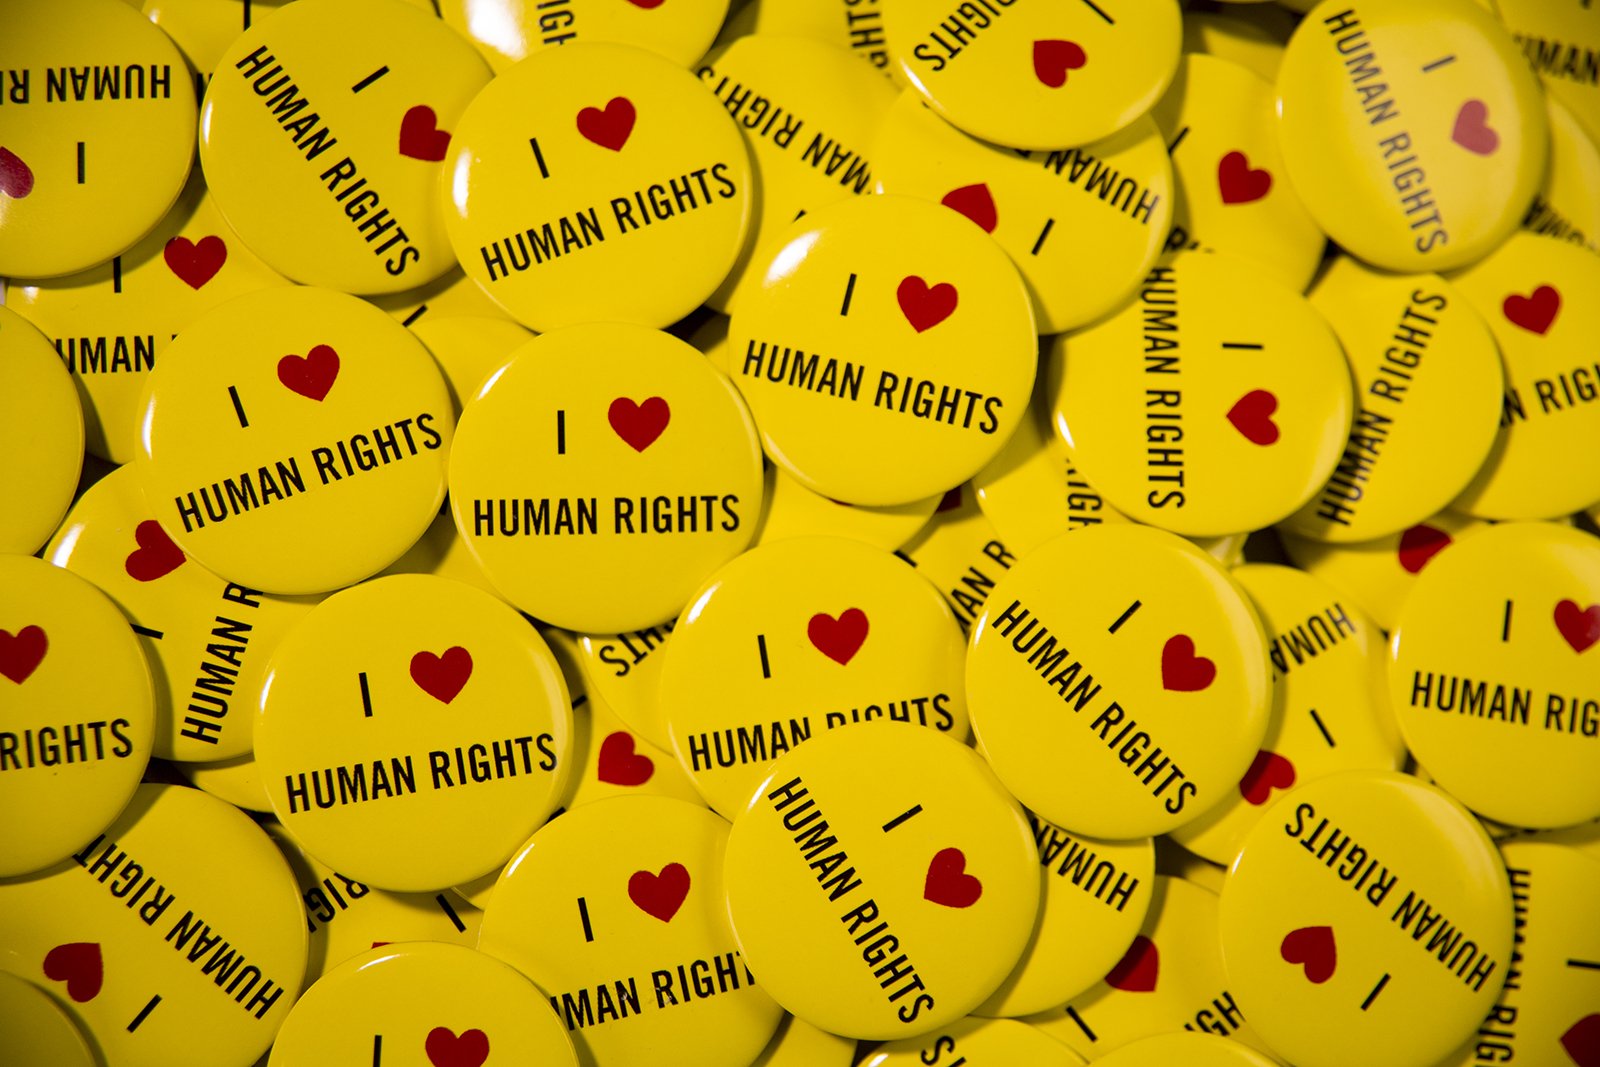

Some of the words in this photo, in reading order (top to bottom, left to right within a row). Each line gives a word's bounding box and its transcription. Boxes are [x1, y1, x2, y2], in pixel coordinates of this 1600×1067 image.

[47, 64, 170, 102] HUMAN
[352, 66, 389, 93] I
[1422, 56, 1456, 72] I
[1324, 9, 1399, 126] HUMAN
[1378, 131, 1448, 253] RIGHTS
[78, 142, 85, 184] I
[236, 46, 337, 161] HUMAN
[320, 157, 420, 275] RIGHTS
[530, 138, 549, 178] I
[801, 132, 871, 195] MAN
[481, 208, 604, 281] HUMAN
[611, 163, 736, 233] RIGHTS
[1032, 219, 1054, 255] I
[841, 274, 856, 316] I
[1139, 267, 1179, 373] HUMAN
[55, 335, 155, 374] UMAN
[228, 386, 249, 428] I
[743, 340, 864, 401] HUMAN
[874, 371, 1002, 434] RIGHTS
[1315, 407, 1393, 526] HUMAN
[1369, 289, 1447, 403] RIGHTS
[558, 410, 565, 454] I
[1146, 390, 1185, 508] RIGHTS
[175, 457, 305, 532] HUMAN
[312, 413, 442, 485] RIGHTS
[474, 498, 597, 536] HUMAN
[615, 495, 739, 534] RIGHTS
[1108, 600, 1141, 634] I
[1502, 600, 1512, 641] I
[758, 635, 771, 678] I
[1270, 602, 1356, 680] HUMA
[181, 616, 252, 744] HUMAN
[359, 672, 373, 717] I
[1411, 671, 1530, 724] HUMAN
[992, 600, 1102, 712] HUMAN
[1090, 702, 1196, 814] RIGHTS
[1310, 710, 1335, 747] I
[0, 718, 133, 771] RIGHTS
[689, 717, 811, 771] HUMAN
[286, 756, 416, 813] HUMAN
[429, 733, 556, 789] RIGHTS
[882, 804, 922, 832] I
[1285, 803, 1397, 906] RIGHTS
[72, 833, 175, 926] RIGHT
[768, 777, 862, 902] HUMAN
[841, 899, 934, 1023] RIGHTS
[436, 894, 466, 933] I
[578, 897, 594, 942] I
[1392, 891, 1495, 992] HUMAN
[165, 911, 284, 1019] HUMAN
[127, 995, 162, 1033] I
[1361, 973, 1390, 1010] I
[1065, 1005, 1097, 1042] I
